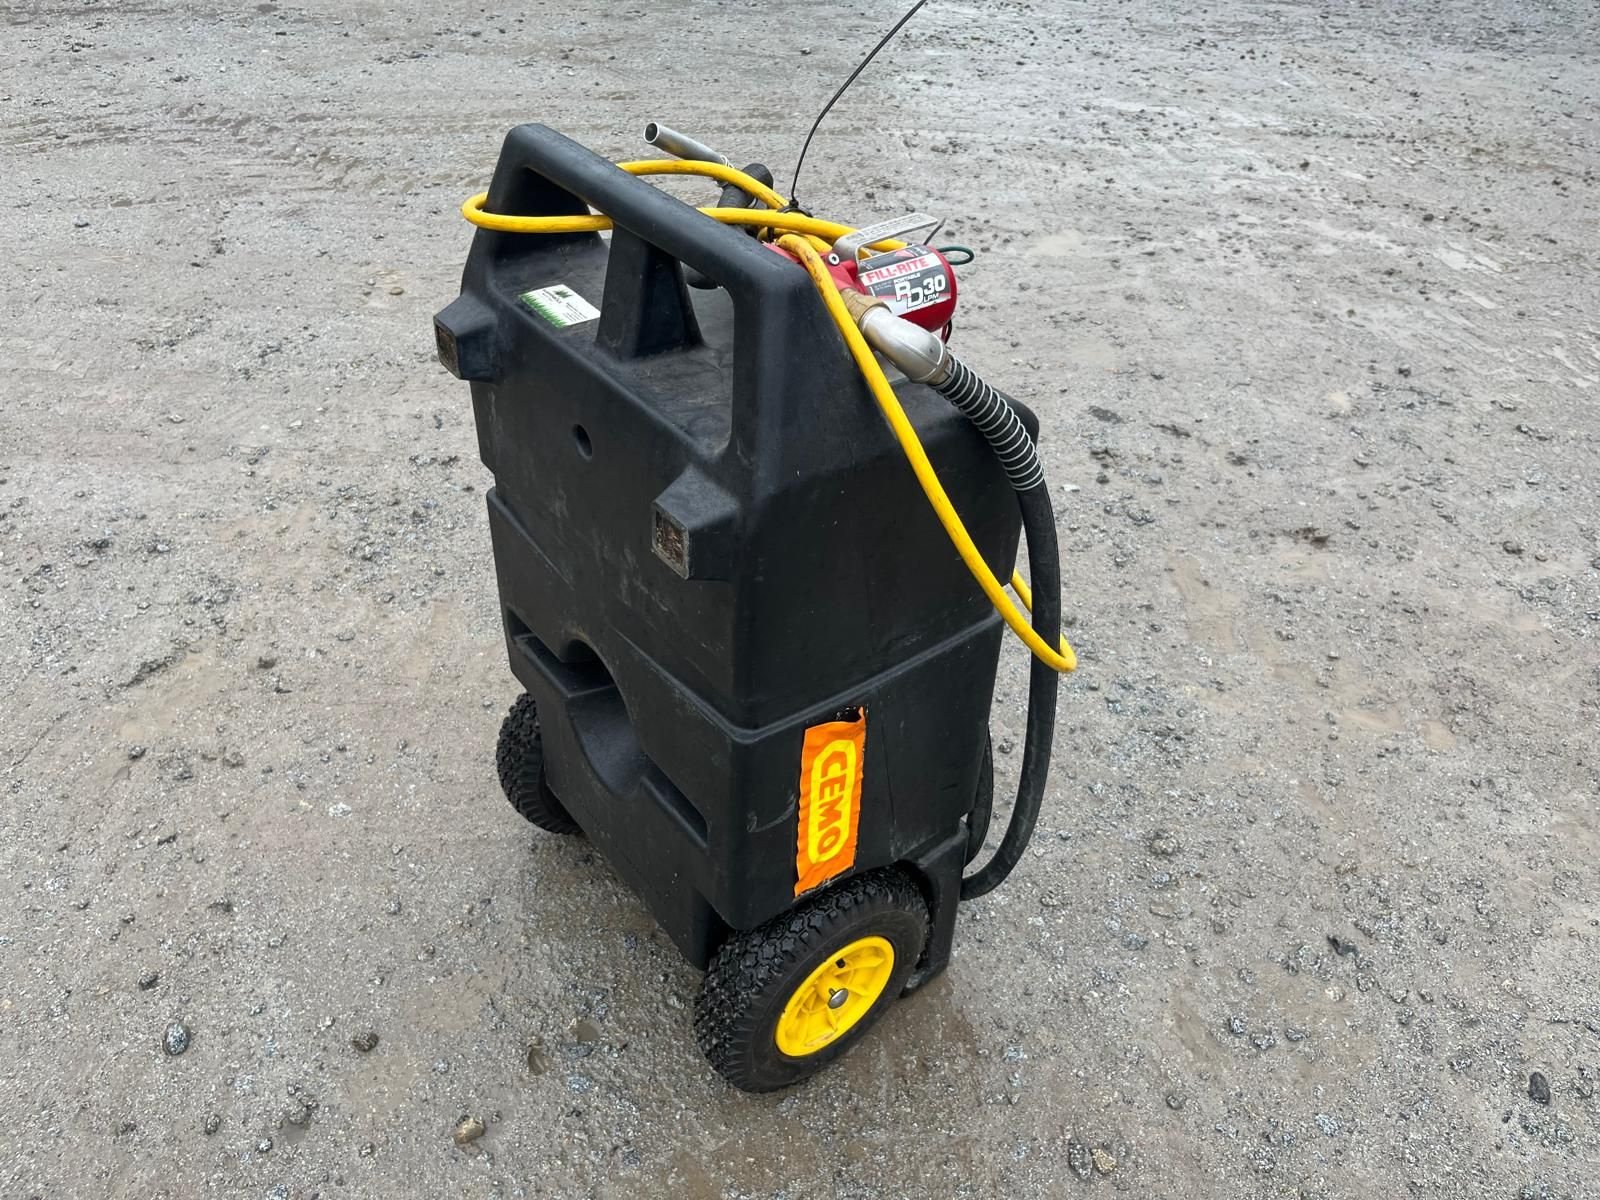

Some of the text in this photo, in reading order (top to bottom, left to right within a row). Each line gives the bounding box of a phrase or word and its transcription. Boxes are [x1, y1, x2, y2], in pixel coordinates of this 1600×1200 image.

[865, 257, 929, 282] FILL-RITE
[924, 293, 940, 302] LPM
[817, 751, 847, 855] CEMO
